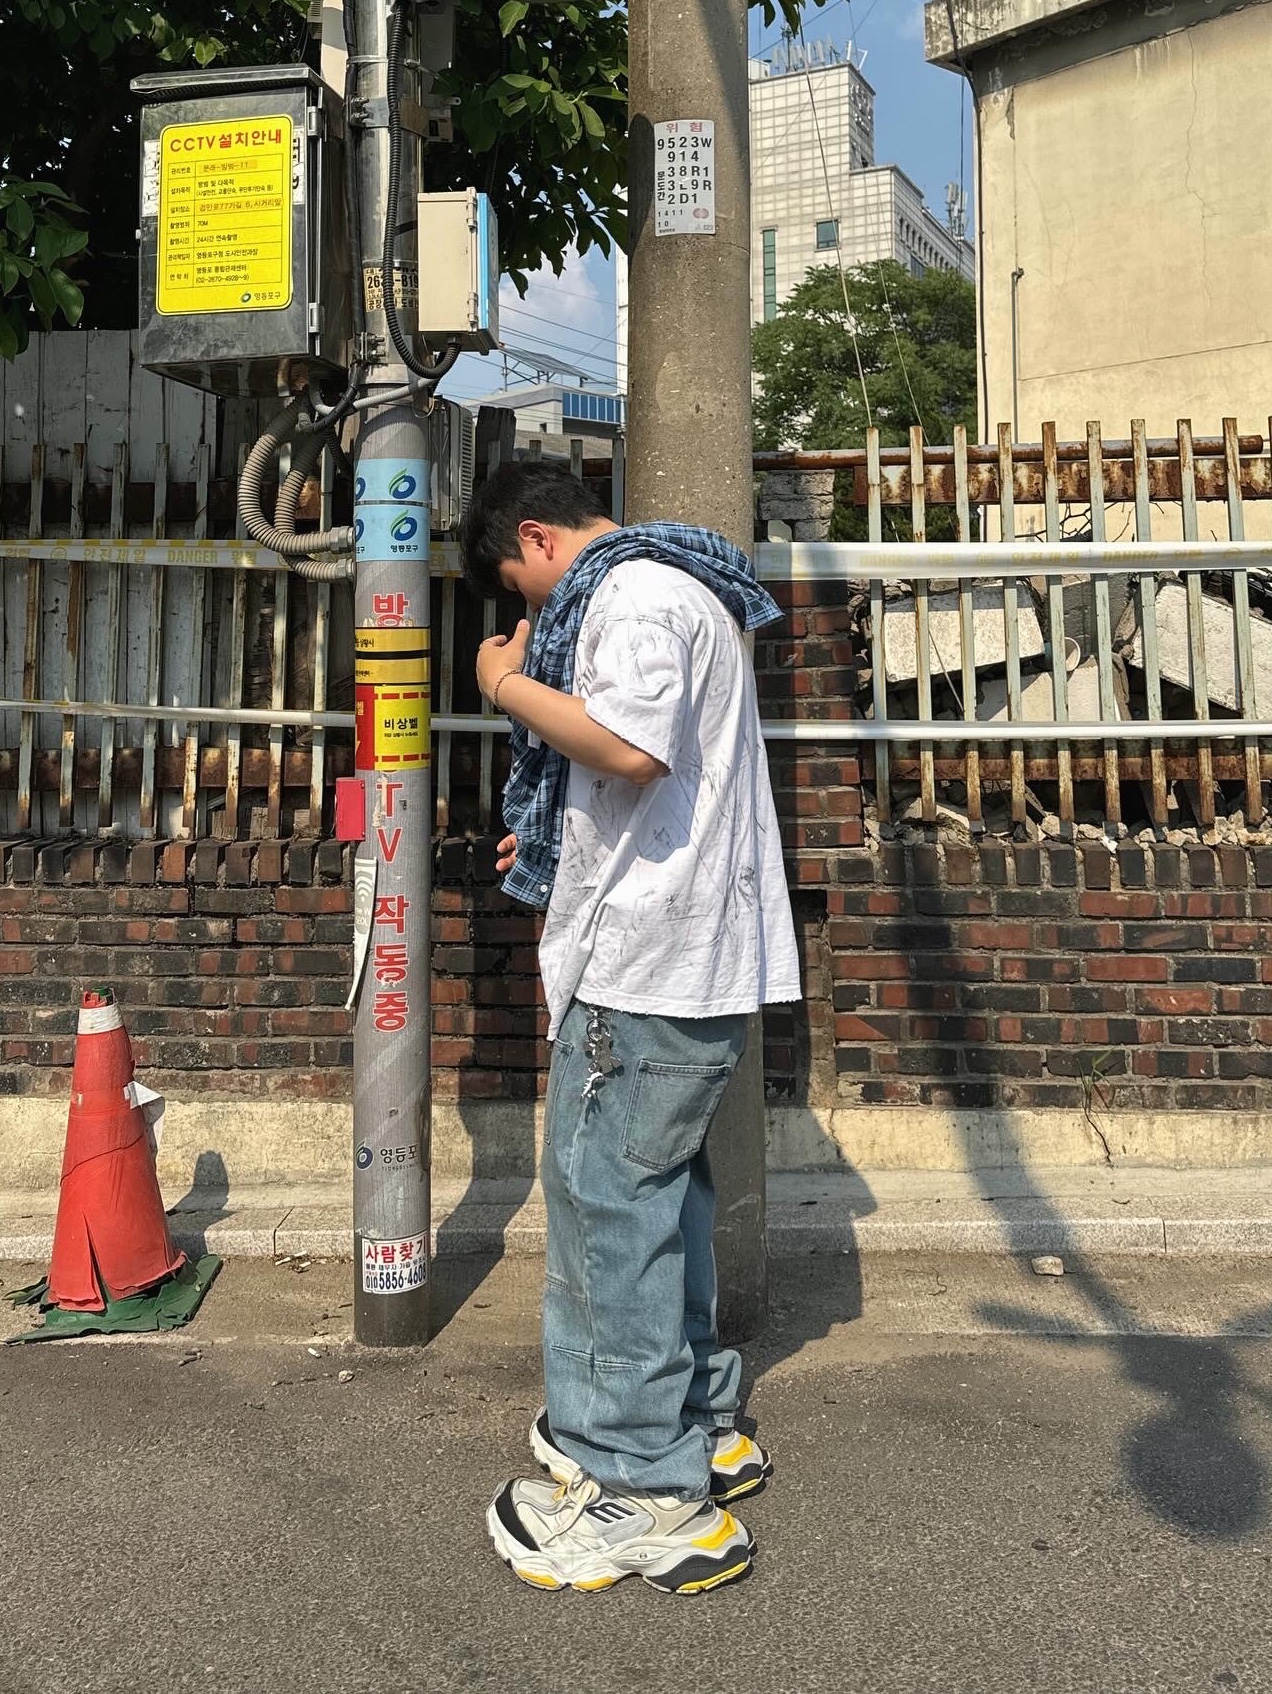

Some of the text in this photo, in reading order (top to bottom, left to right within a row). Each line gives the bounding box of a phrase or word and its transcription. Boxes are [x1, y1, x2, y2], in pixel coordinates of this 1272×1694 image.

[657, 136, 712, 150] 9523W
[667, 151, 699, 163] 914
[667, 165, 709, 177] 38R1
[667, 193, 698, 205] 2D1
[390, 545, 418, 553] 영등포구
[166, 550, 219, 564] DANGER
[384, 717, 418, 730] 비상벨
[373, 894, 410, 1032] 작동중
[380, 1144, 418, 1164] 영등포
